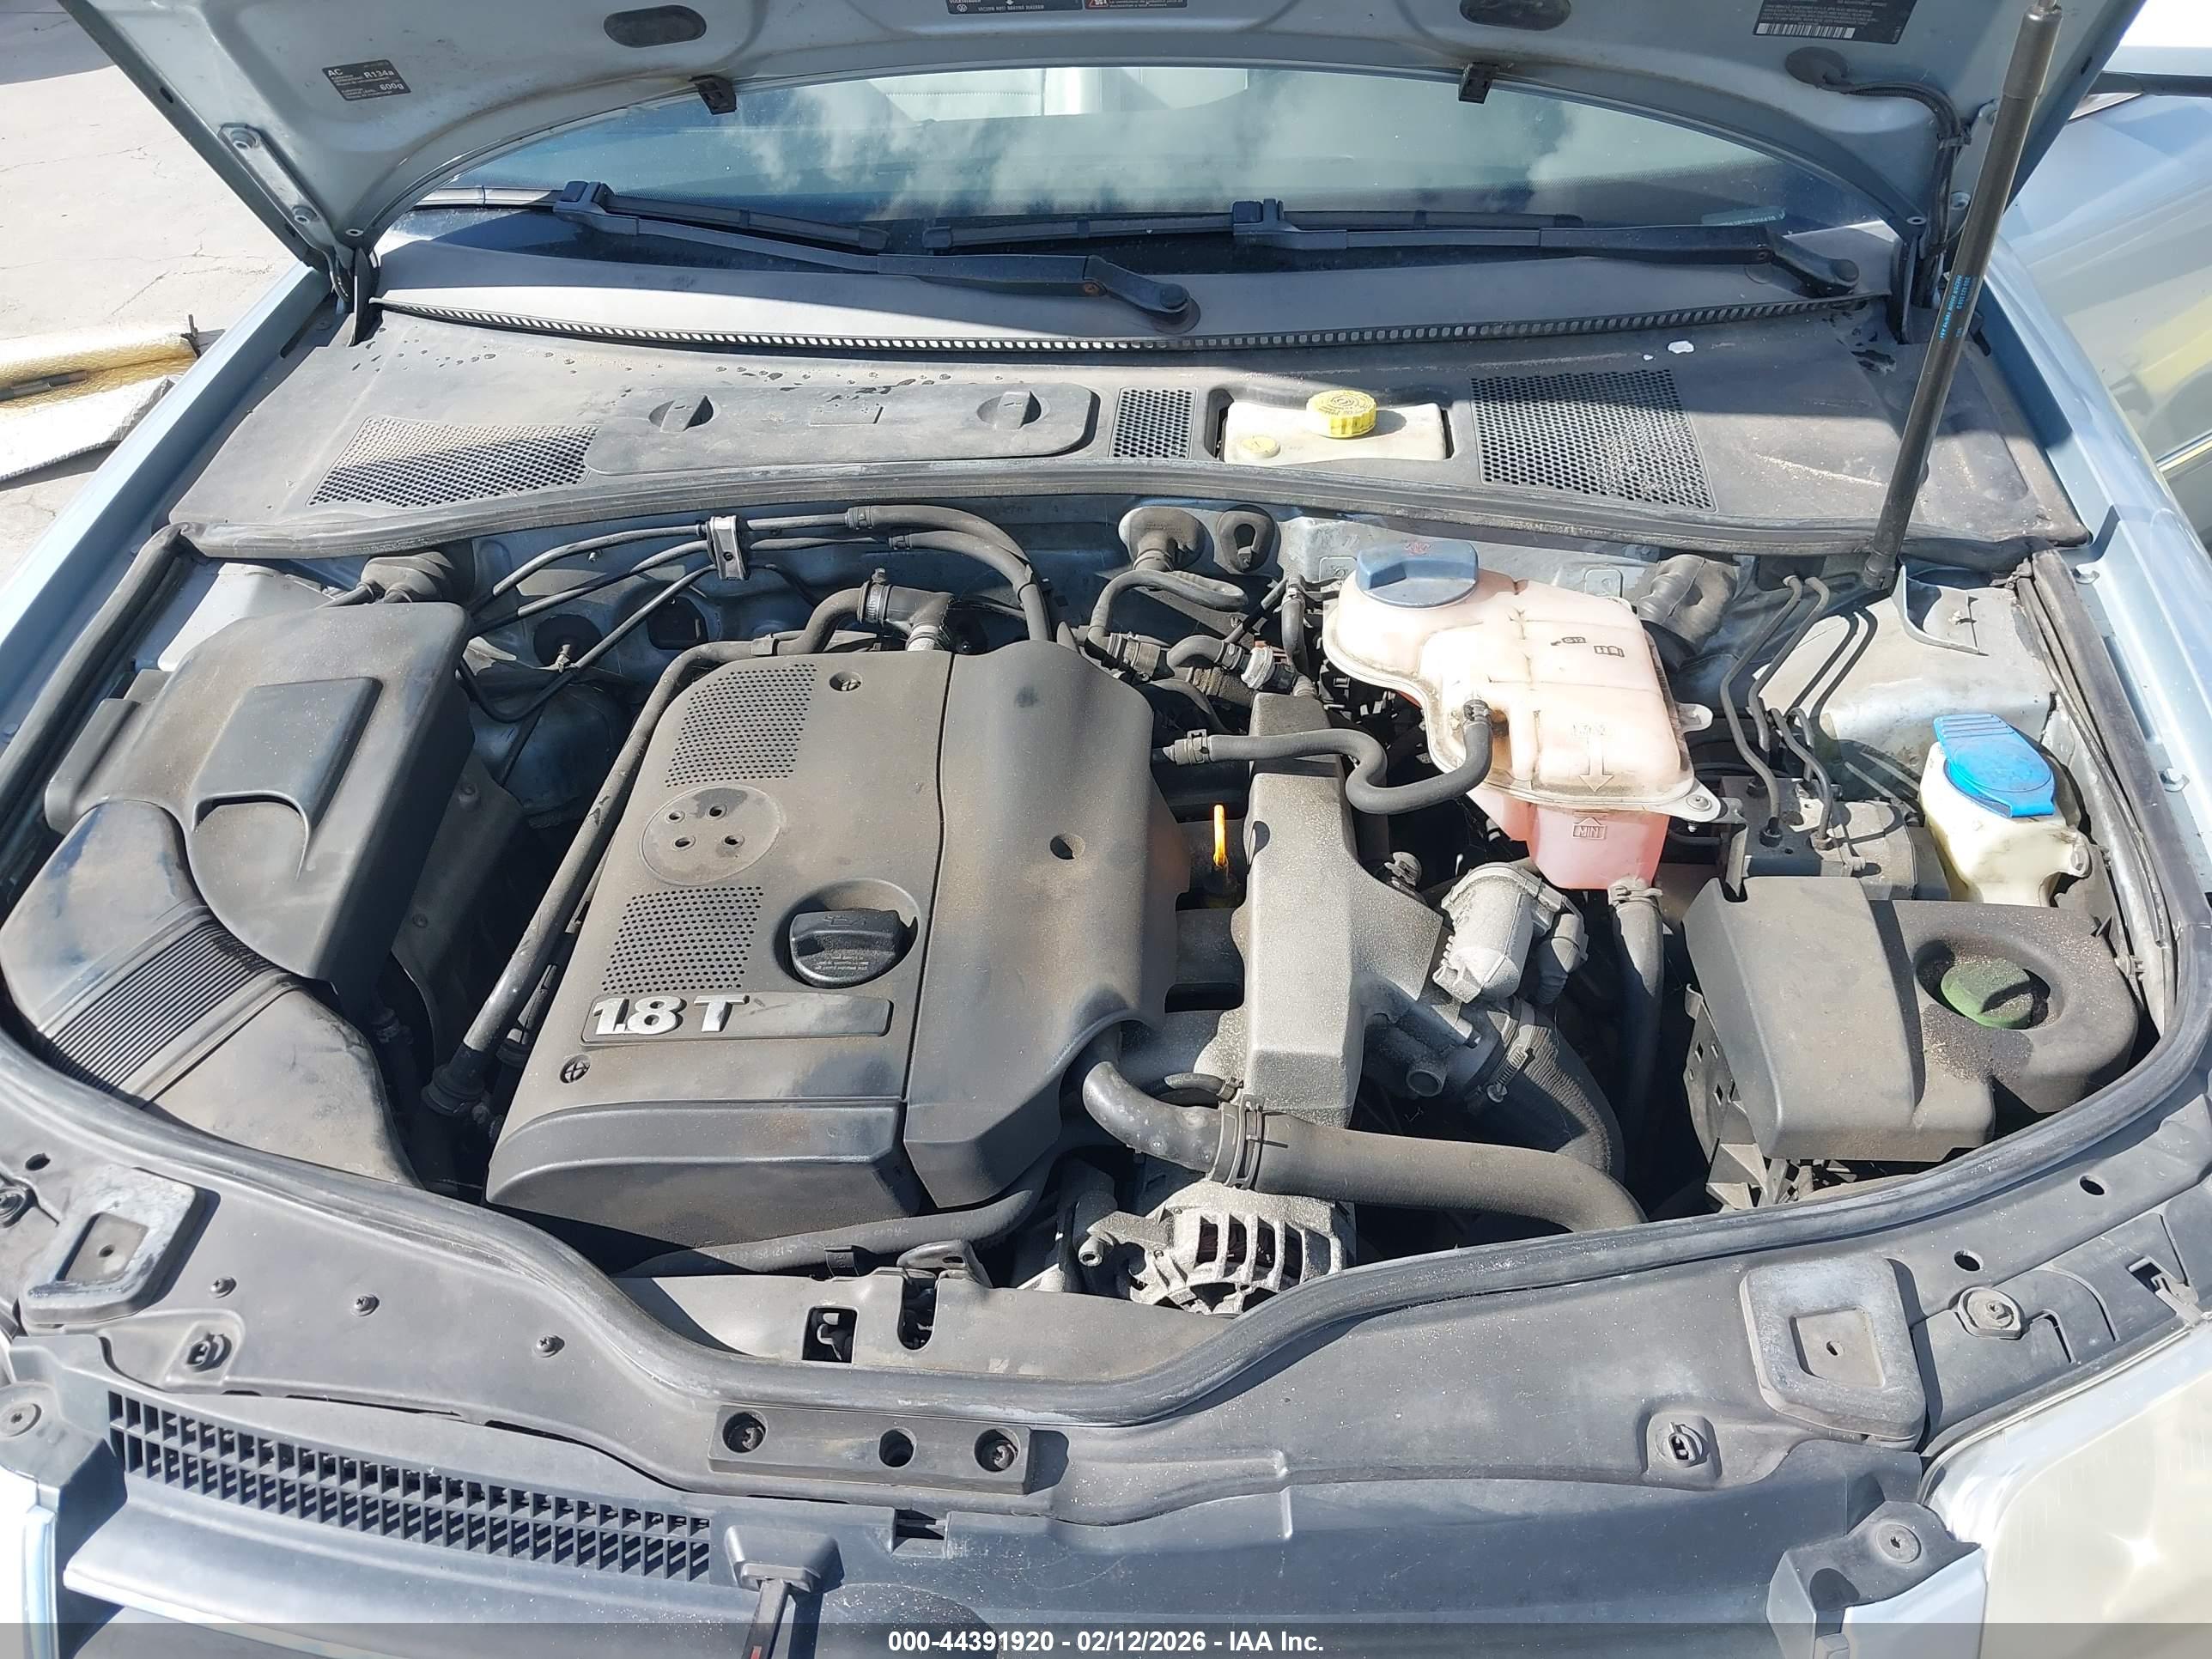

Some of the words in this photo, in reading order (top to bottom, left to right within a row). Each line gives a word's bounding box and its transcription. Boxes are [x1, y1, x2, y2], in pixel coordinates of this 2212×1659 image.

[364, 70, 394, 79] R134a
[1580, 826, 1600, 837] MIN
[694, 994, 750, 1032] T
